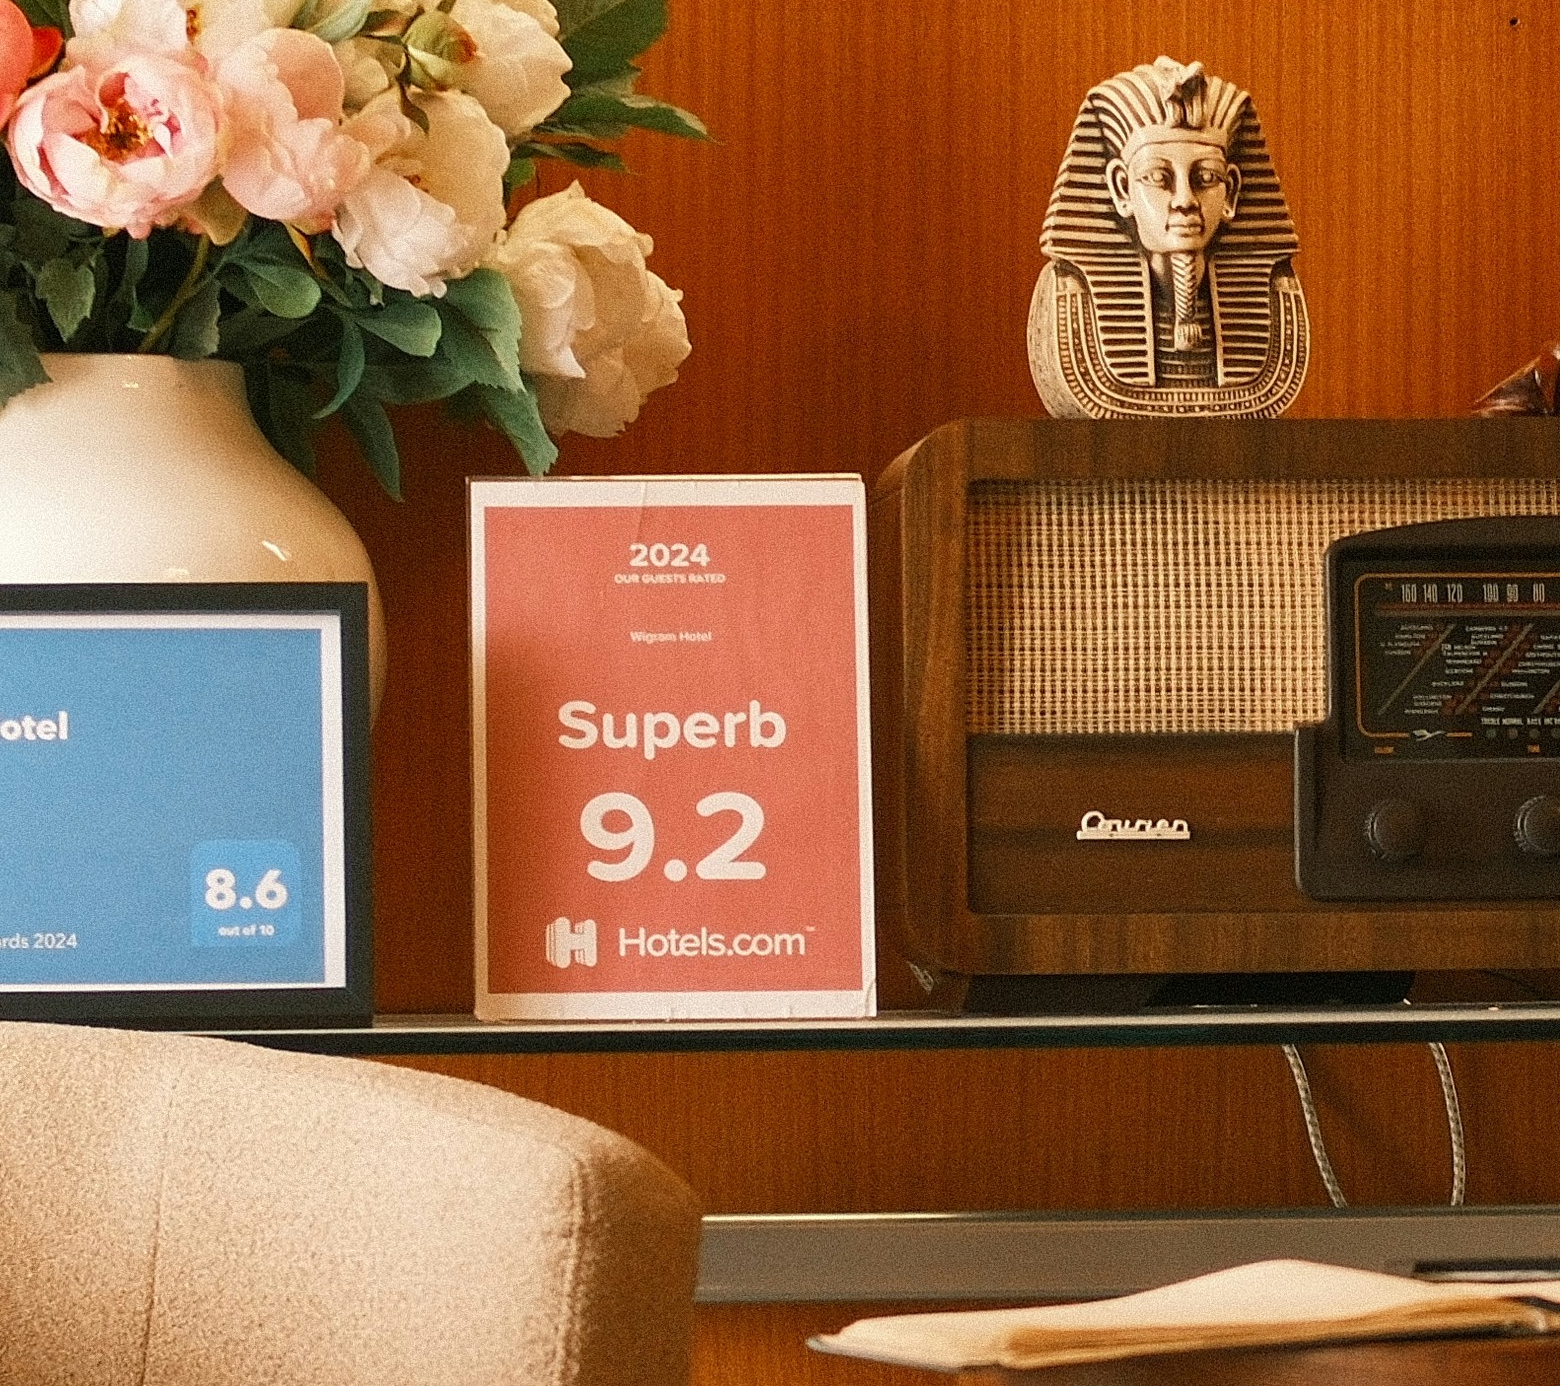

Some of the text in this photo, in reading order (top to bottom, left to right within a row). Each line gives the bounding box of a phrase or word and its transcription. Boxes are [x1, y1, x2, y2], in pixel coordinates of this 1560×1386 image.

[629, 542, 710, 569] 2024
[614, 572, 727, 584] OUR GUESTS RATED
[1401, 583, 1417, 603] 160
[1423, 583, 1438, 603] 140
[1447, 583, 1463, 603] 120
[629, 630, 713, 645] Wigram Hotel
[557, 699, 787, 761] Superb
[579, 792, 767, 883] 9.2
[204, 868, 288, 912] 8.6
[33, 933, 78, 949] 2024
[217, 924, 275, 937] out of 10
[618, 925, 807, 958] Hotels.com
